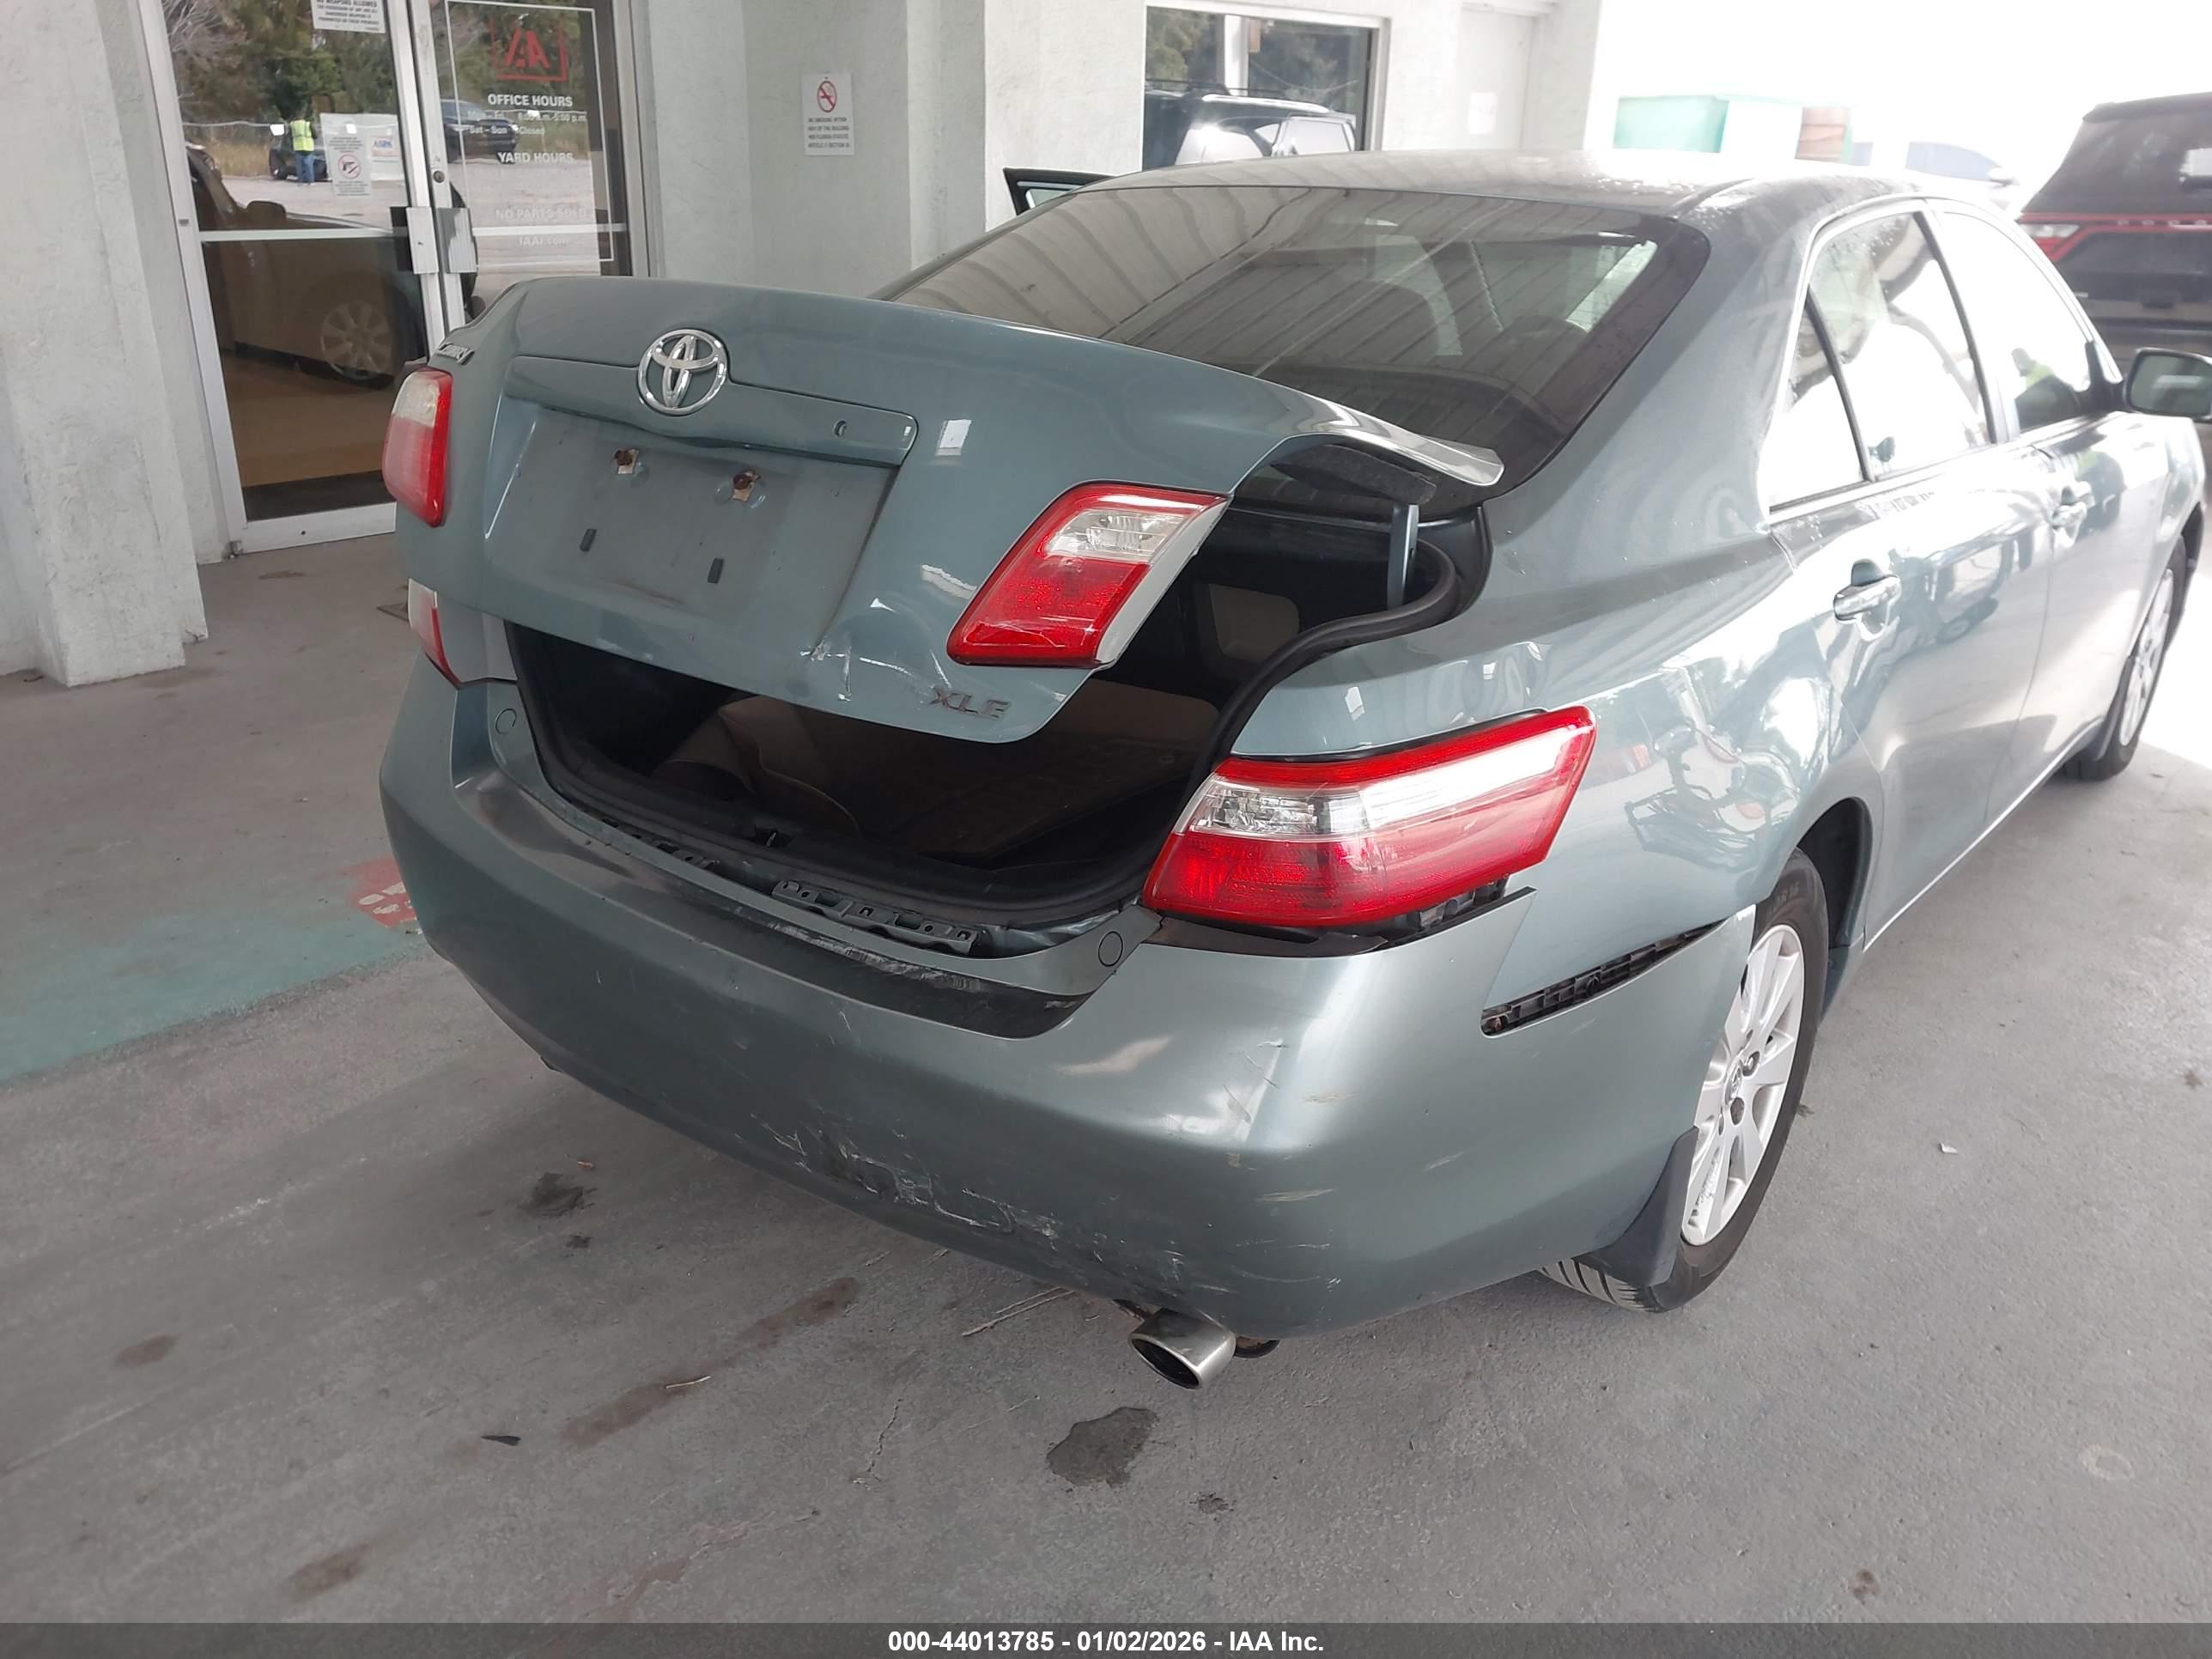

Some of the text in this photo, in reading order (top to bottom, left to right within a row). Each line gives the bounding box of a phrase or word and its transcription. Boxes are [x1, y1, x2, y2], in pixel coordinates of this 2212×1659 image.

[488, 94, 573, 107] OFFICE HOURS
[497, 152, 573, 163] YARD HOURS
[495, 210, 514, 220] NO
[517, 209, 554, 219] PARTS
[929, 687, 1011, 721] XLE
